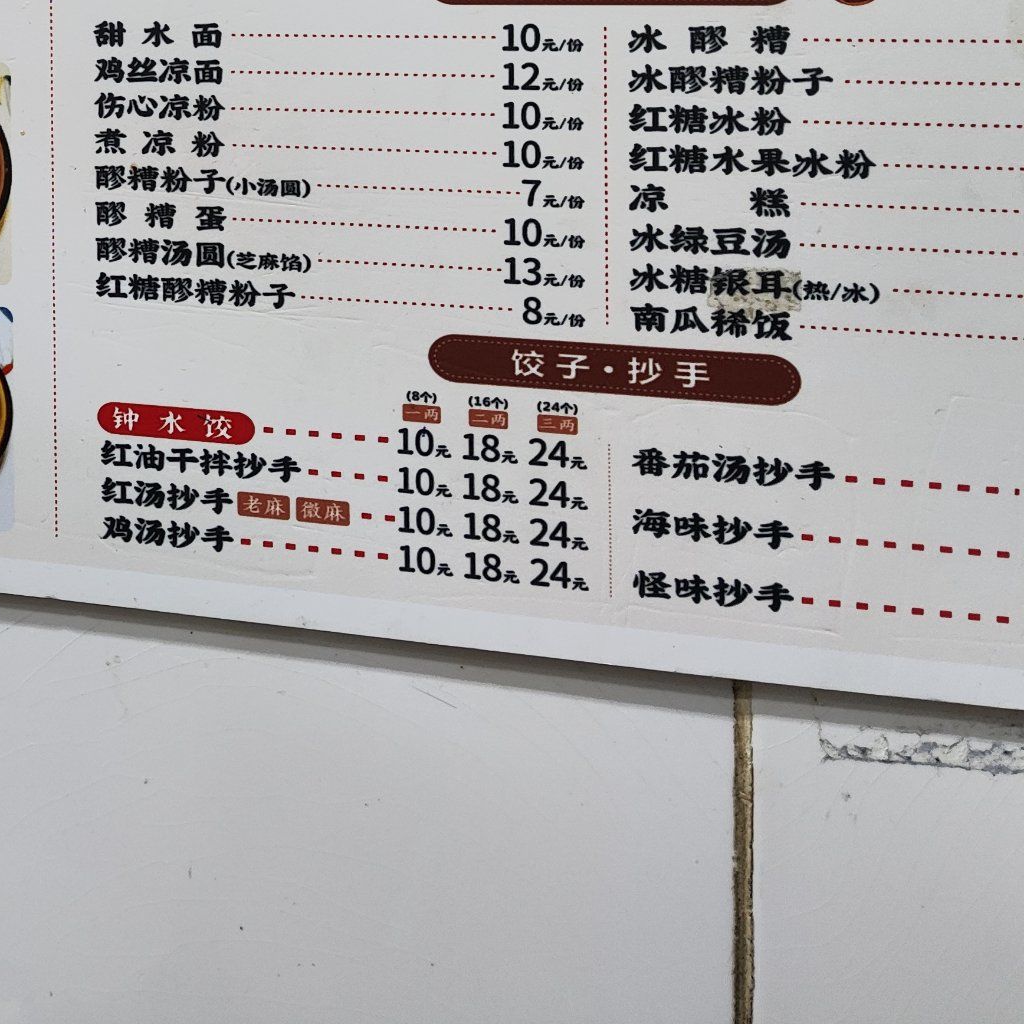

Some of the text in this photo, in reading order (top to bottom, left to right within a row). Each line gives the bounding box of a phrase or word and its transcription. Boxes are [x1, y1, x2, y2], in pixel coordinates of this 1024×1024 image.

[94, 57, 224, 85] 鸡丝凉面
[628, 64, 834, 96] 冰醪糟粉子
[94, 93, 225, 123] 伤心凉粉
[628, 103, 792, 136] 红糖冰粉
[628, 143, 876, 180] 红糖水果冰粉
[521, 179, 585, 211] 7元/份
[629, 223, 791, 259] 冰绿豆汤
[96, 275, 296, 309] 红糖醪糟粉子
[629, 303, 793, 341] 南瓜稀饭
[406, 389, 579, 416] (8个) (16个) (24个)
[101, 440, 302, 483] 红油干拌抄手
[397, 427, 451, 459] 10元
[462, 432, 519, 464] 18元
[528, 438, 588, 470] 24元
[631, 447, 836, 491] 番茄汤抄手
[101, 478, 234, 515] 红汤抄手
[242, 496, 287, 517] 老麻
[102, 515, 235, 552] 鸡汤抄手
[632, 508, 794, 550] 海味抄手
[632, 569, 795, 613] 怪味抄手
